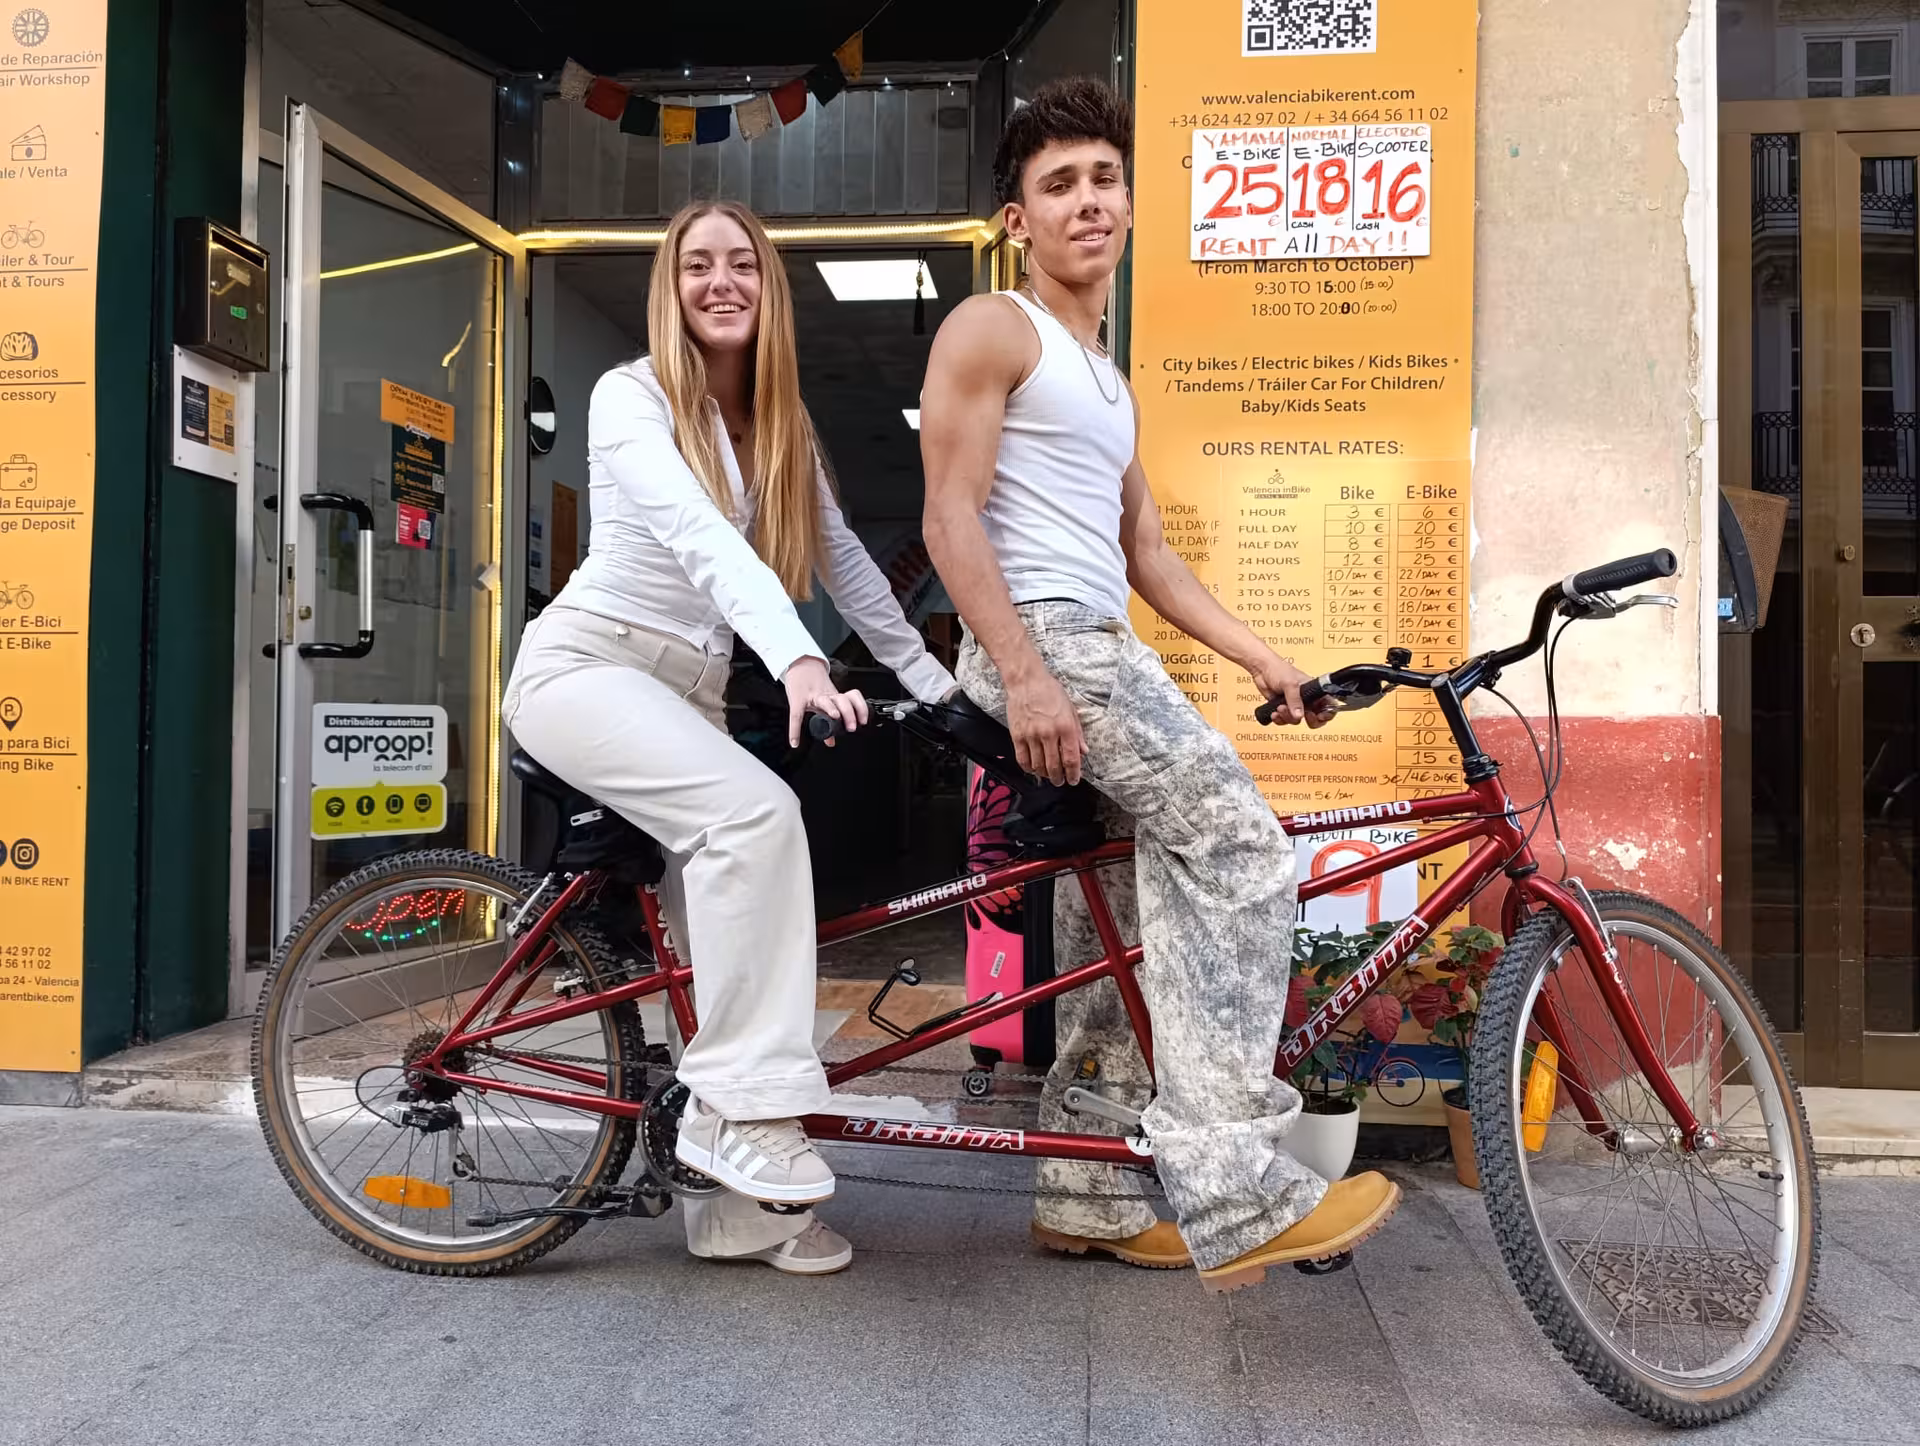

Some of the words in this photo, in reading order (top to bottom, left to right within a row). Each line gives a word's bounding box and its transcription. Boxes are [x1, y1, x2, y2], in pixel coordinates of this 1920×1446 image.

[1, 54, 18, 65] de
[22, 51, 103, 66] Reparación
[19, 73, 90, 87] Workshop
[1201, 88, 1415, 105] www.valenciabikerent.com
[1169, 114, 1198, 127] +34
[1201, 113, 1229, 126] 624
[1233, 112, 1251, 126] 42
[1255, 112, 1274, 125] 97
[1278, 111, 1296, 125] 02
[1329, 110, 1348, 123] 34
[1351, 109, 1380, 122] 664
[1384, 108, 1402, 122] 56
[1408, 108, 1424, 121] 11
[1429, 107, 1448, 121] 02
[1202, 131, 1285, 149] YAMAHA
[1291, 129, 1350, 142] NORMAL
[1357, 126, 1426, 139] ELECTRIC
[1357, 140, 1429, 158] SCOOTER
[28, 166, 68, 178] Venta
[1202, 163, 1284, 219] 25
[1291, 157, 1351, 218] 18
[1361, 159, 1426, 222] 16
[1193, 221, 1216, 231] CASH
[1291, 221, 1314, 229] CASH
[1355, 222, 1380, 231] CASH
[1200, 237, 1276, 257] RENT
[42, 253, 75, 265] Tour
[1198, 260, 1248, 278] (From
[1253, 259, 1307, 273] March
[1313, 260, 1330, 272] to
[1335, 257, 1414, 274] October)
[26, 275, 65, 287] Tours
[1255, 281, 1286, 295] 9:30
[1290, 281, 1310, 294] TO
[1252, 302, 1291, 316] 18:00
[1294, 302, 1314, 315] TO
[1162, 358, 1193, 374] City
[1197, 357, 1237, 371] bikes
[1252, 356, 1309, 370] Electric
[1313, 355, 1354, 369] bikes
[1369, 354, 1402, 369] Kids
[1407, 354, 1448, 368] Bikes
[1174, 378, 1244, 393] Tandems
[1257, 377, 1307, 391] Tráiler
[1311, 377, 1337, 391] Car
[1342, 377, 1366, 390] For
[1370, 376, 1445, 390] Children/
[1, 391, 57, 403] cessory
[1241, 399, 1320, 416] Baby/Kids
[1324, 399, 1366, 412] Seats
[1202, 442, 1255, 456] OURS
[1260, 441, 1333, 455] RENTAL
[1339, 440, 1404, 455] RATES:
[1242, 486, 1281, 494] Valencia
[1283, 485, 1311, 494] inBike
[1340, 485, 1375, 500] Bike
[1407, 484, 1457, 499] E-Bike
[15, 496, 77, 511] Equipaje
[1165, 505, 1198, 515] HOUR
[1249, 508, 1286, 517] HOUR
[1346, 505, 1360, 519] 3
[1423, 505, 1434, 519] 6
[1, 521, 18, 533] ge
[22, 518, 76, 532] Deposit
[1185, 520, 1208, 530] DAY
[1238, 525, 1268, 533] FULL
[1272, 524, 1297, 533] DAY
[1345, 521, 1365, 534] 10
[1413, 521, 1436, 535] 20
[1238, 541, 1271, 550] HALF
[1274, 540, 1299, 549] DAY
[1348, 537, 1360, 550] 8
[1415, 537, 1436, 549] 15
[1238, 557, 1252, 565] 24
[1256, 557, 1301, 565] HOURS
[1343, 553, 1364, 566] 12
[1413, 553, 1436, 566] 25
[1237, 573, 1245, 581] 2
[1248, 573, 1281, 581] DAYS
[1237, 589, 1244, 597] 3
[1247, 589, 1264, 597] TO
[1268, 589, 1275, 597] 5
[1278, 589, 1310, 597] DAYS
[1237, 603, 1244, 611] 6
[1246, 603, 1262, 611] TO
[1266, 603, 1279, 611] 10
[1282, 603, 1312, 611] DAYS
[20, 615, 62, 628] E-Bici
[1251, 620, 1266, 628] TO
[1270, 620, 1281, 628] 15
[1284, 620, 1312, 628] DAYS
[1154, 630, 1168, 640] 20
[1268, 636, 1278, 645] TO
[1286, 637, 1315, 645] MONTH
[6, 637, 52, 650] E-Bike
[1160, 653, 1215, 665] UGGAGE
[1422, 654, 1435, 668] 1
[1423, 692, 1437, 705] 1
[1412, 710, 1436, 727] 20
[7, 738, 39, 751] para
[43, 736, 70, 749] Bici
[1235, 733, 1279, 742] CHILDREN'S
[1340, 735, 1382, 743] REMOLQUE
[1413, 730, 1437, 745] 10
[324, 731, 433, 762] aproop!
[1308, 753, 1323, 761] FOR
[1331, 753, 1358, 762] HOURS
[1412, 751, 1437, 765] 15
[23, 758, 54, 771] Bike
[1274, 774, 1307, 783] DEPOSIT
[1308, 775, 1322, 783] PER
[1323, 775, 1353, 783] PERSON
[1354, 776, 1377, 784] FROM
[1292, 800, 1412, 828] SHIMANO
[1, 876, 12, 885] IN
[14, 876, 39, 886] BIKE
[41, 877, 70, 887] RENT
[888, 873, 987, 915] SHIMANO
[5, 946, 19, 956] 42
[21, 946, 35, 956] 97
[37, 947, 51, 957] 02
[5, 959, 19, 968] 56
[22, 959, 34, 969] 11
[37, 960, 51, 969] 02
[12, 976, 26, 985] 24
[34, 976, 80, 987] Valencia
[0, 992, 74, 1003] arentbike.com
